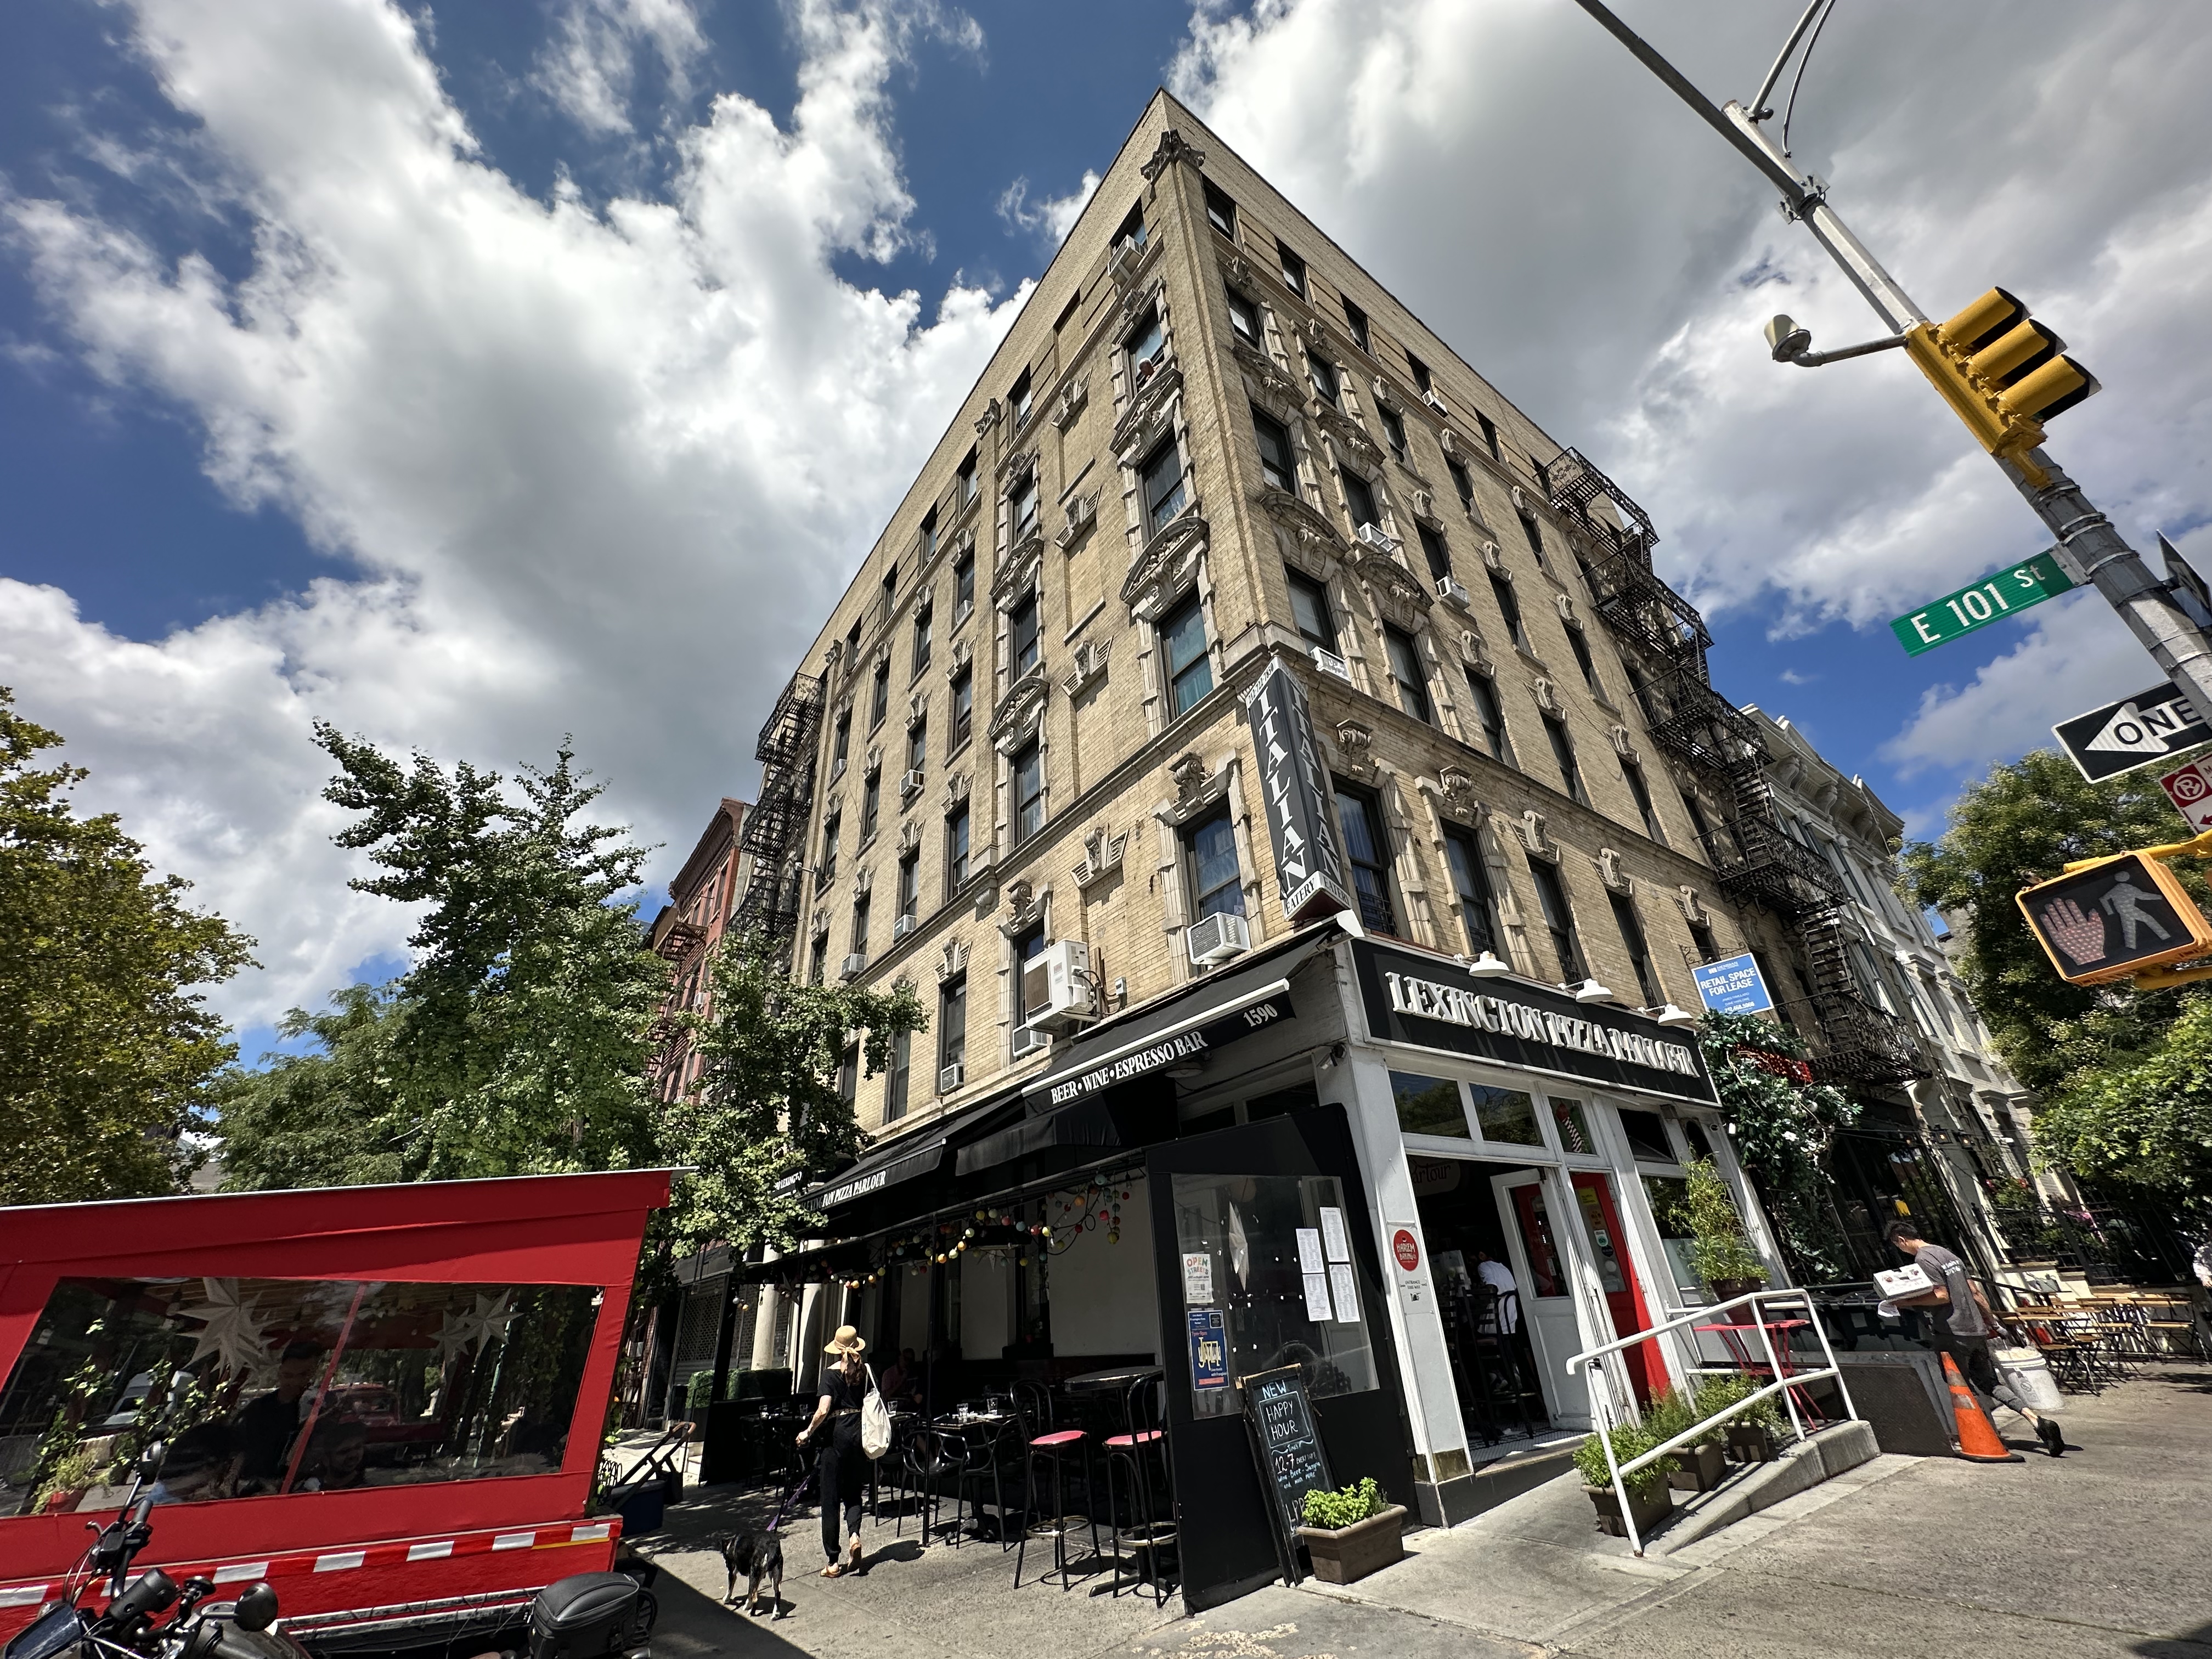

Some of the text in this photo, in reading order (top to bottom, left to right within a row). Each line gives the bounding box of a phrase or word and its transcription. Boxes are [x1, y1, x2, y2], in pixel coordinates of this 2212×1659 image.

[1910, 565, 2045, 644] E 101 St
[2114, 699, 2203, 745] ONE
[1259, 686, 1307, 896] ITALIAN
[1291, 683, 1342, 885] ITALIAN
[1286, 878, 1314, 915] EATERY
[1323, 876, 1350, 907] EATERY
[1700, 968, 1756, 990] RETAIL SPACE
[1708, 978, 1754, 996] FOR LEASE
[1243, 1003, 1278, 1028] 1590
[1385, 972, 1700, 1077] LEXINGTON PIZZA PARLOUR
[1051, 1031, 1209, 1104] BEER WINE ESPRESSO BAR
[834, 1183, 853, 1203] PIZZA
[853, 1170, 887, 1197] PARLOUR
[1396, 1243, 1415, 1253] HARLEM
[1187, 1257, 1207, 1267] OPEN
[1187, 1267, 1209, 1276] STREETS
[1262, 1380, 1286, 1399] NEW
[1266, 1401, 1293, 1423] HAPPY
[1271, 1420, 1298, 1440] HOUR
[1276, 1453, 1294, 1474] 12-7
